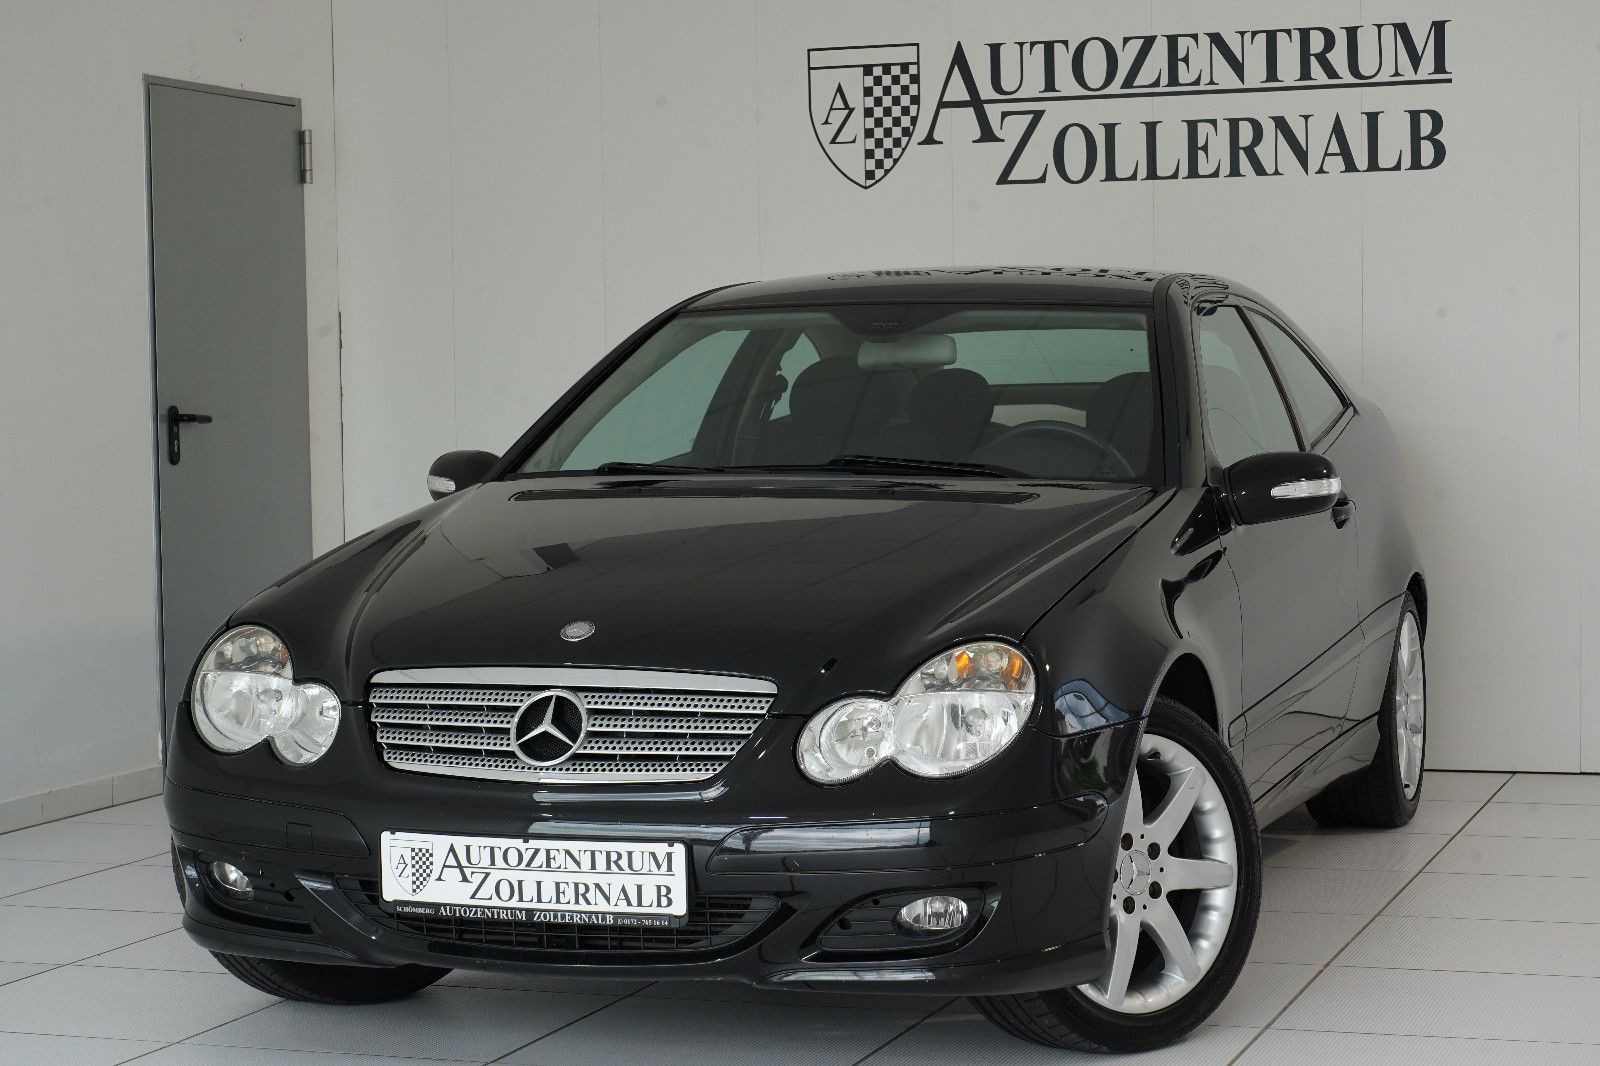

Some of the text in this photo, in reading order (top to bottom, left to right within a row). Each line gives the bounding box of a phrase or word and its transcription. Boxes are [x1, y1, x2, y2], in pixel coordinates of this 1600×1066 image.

[917, 20, 1452, 145] AUTOZENTRUM
[995, 108, 1447, 186] ZOLLERNALB
[435, 843, 674, 883] AUTOZENTRUM
[470, 871, 673, 908] ZOLLERNALB
[438, 906, 526, 920] AUTOZENTRUM
[533, 911, 614, 925] ZOLLERNALB
